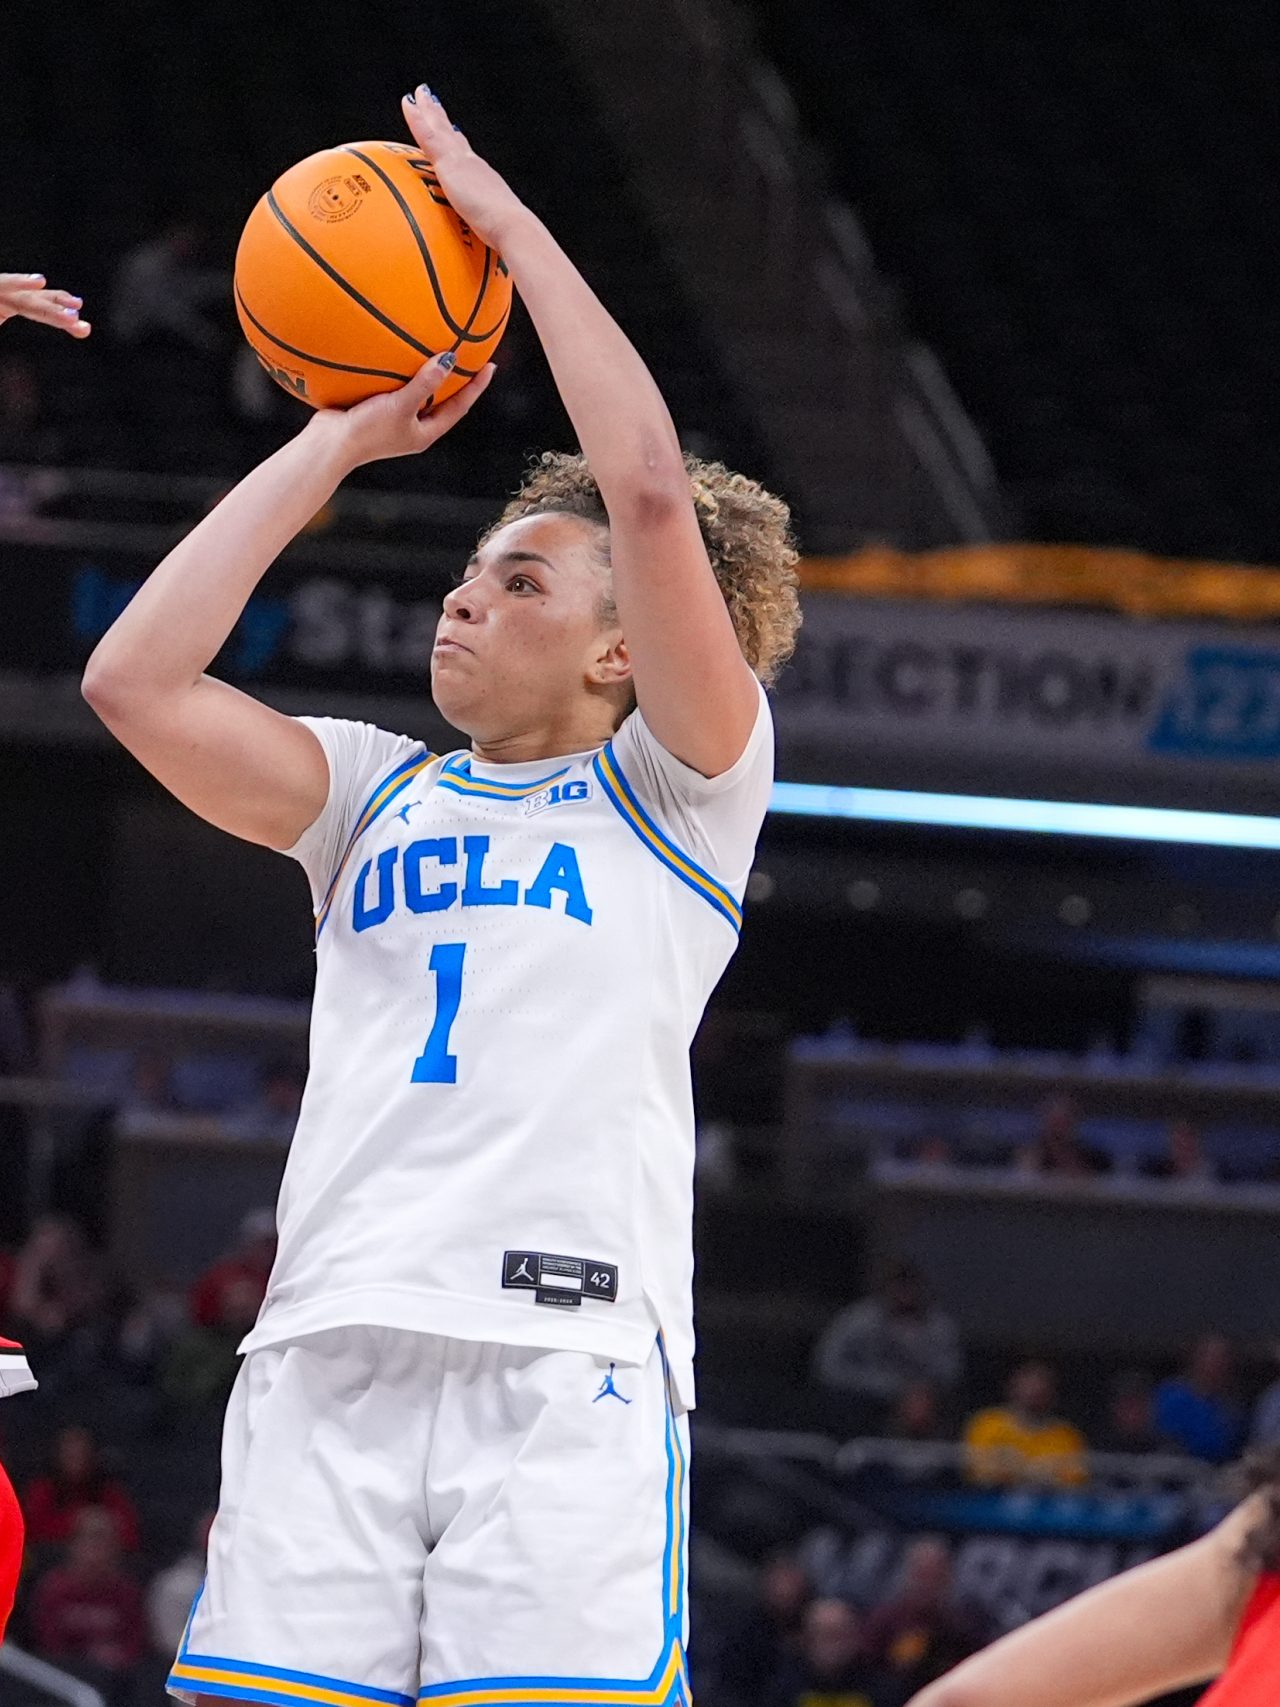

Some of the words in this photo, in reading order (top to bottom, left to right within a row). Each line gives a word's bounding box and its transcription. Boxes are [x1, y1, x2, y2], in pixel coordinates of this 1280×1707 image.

[353, 836, 593, 933] UCLA
[410, 943, 467, 1083] 1
[590, 1271, 610, 1288] 42
